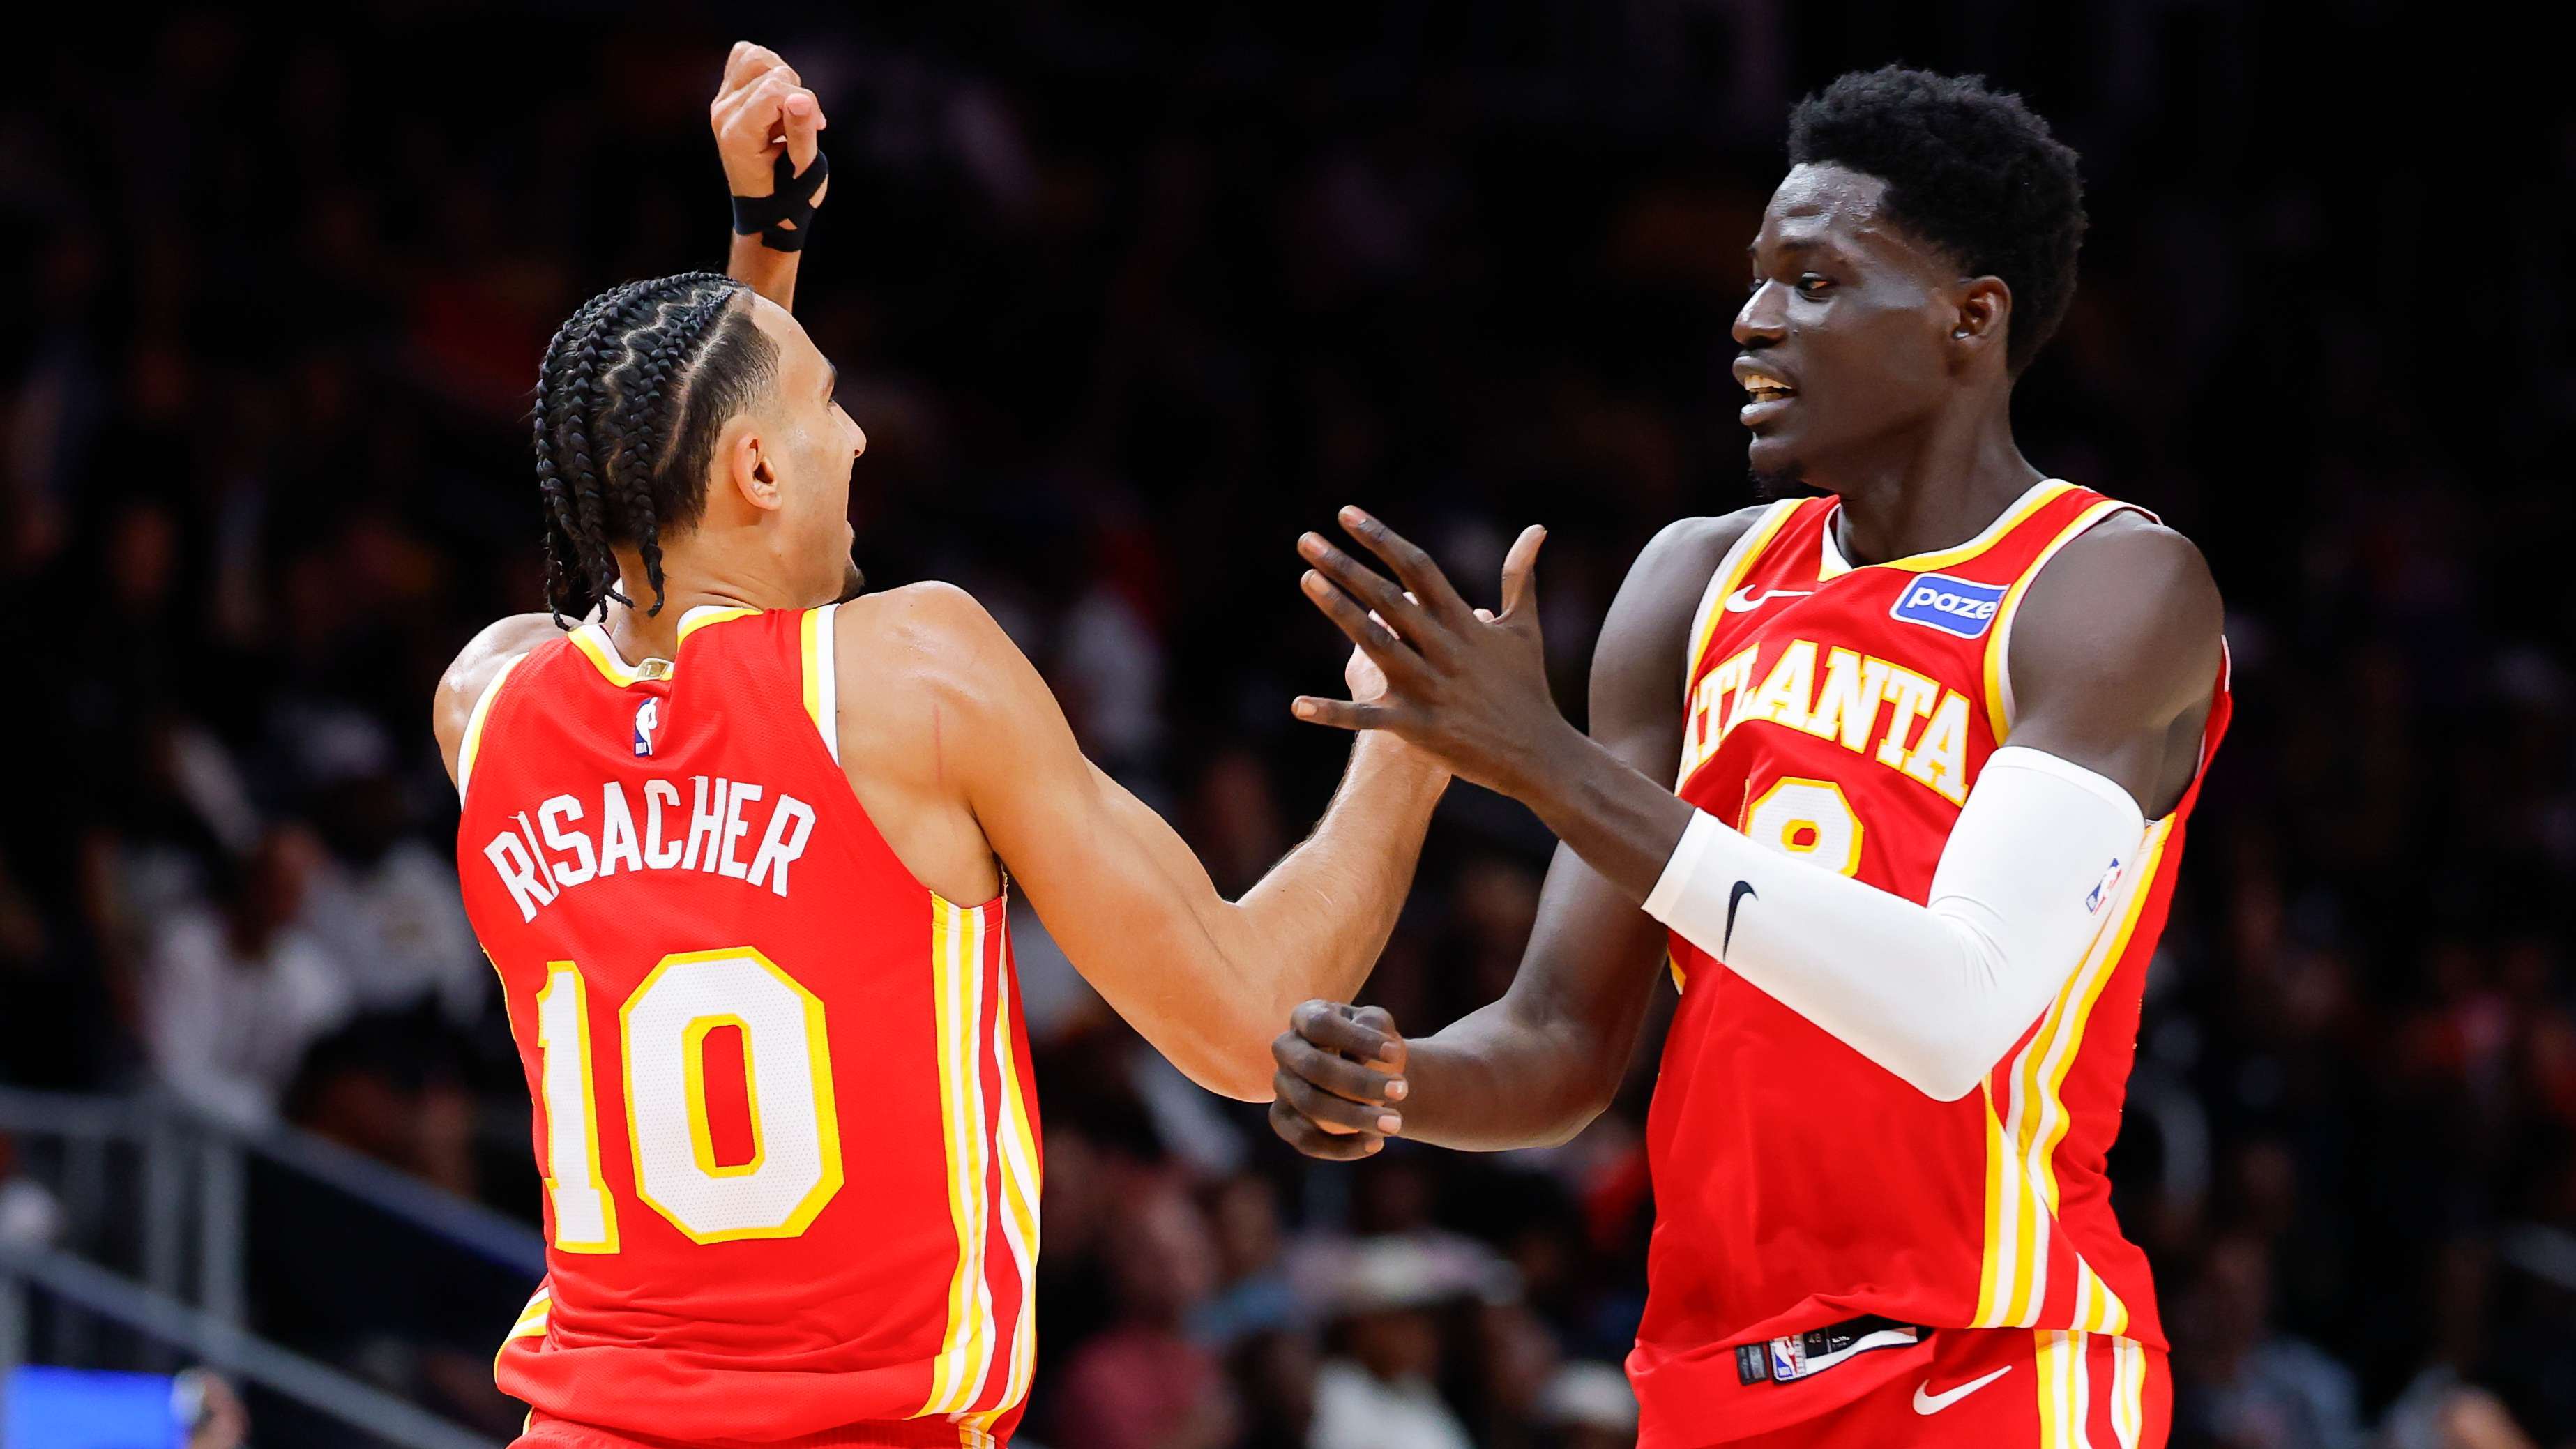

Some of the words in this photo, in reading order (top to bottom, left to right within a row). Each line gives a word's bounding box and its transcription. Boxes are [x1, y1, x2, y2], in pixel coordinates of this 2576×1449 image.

[1906, 586, 1999, 620] paze
[483, 775, 816, 923] RISACHER
[536, 946, 845, 1254] 10
